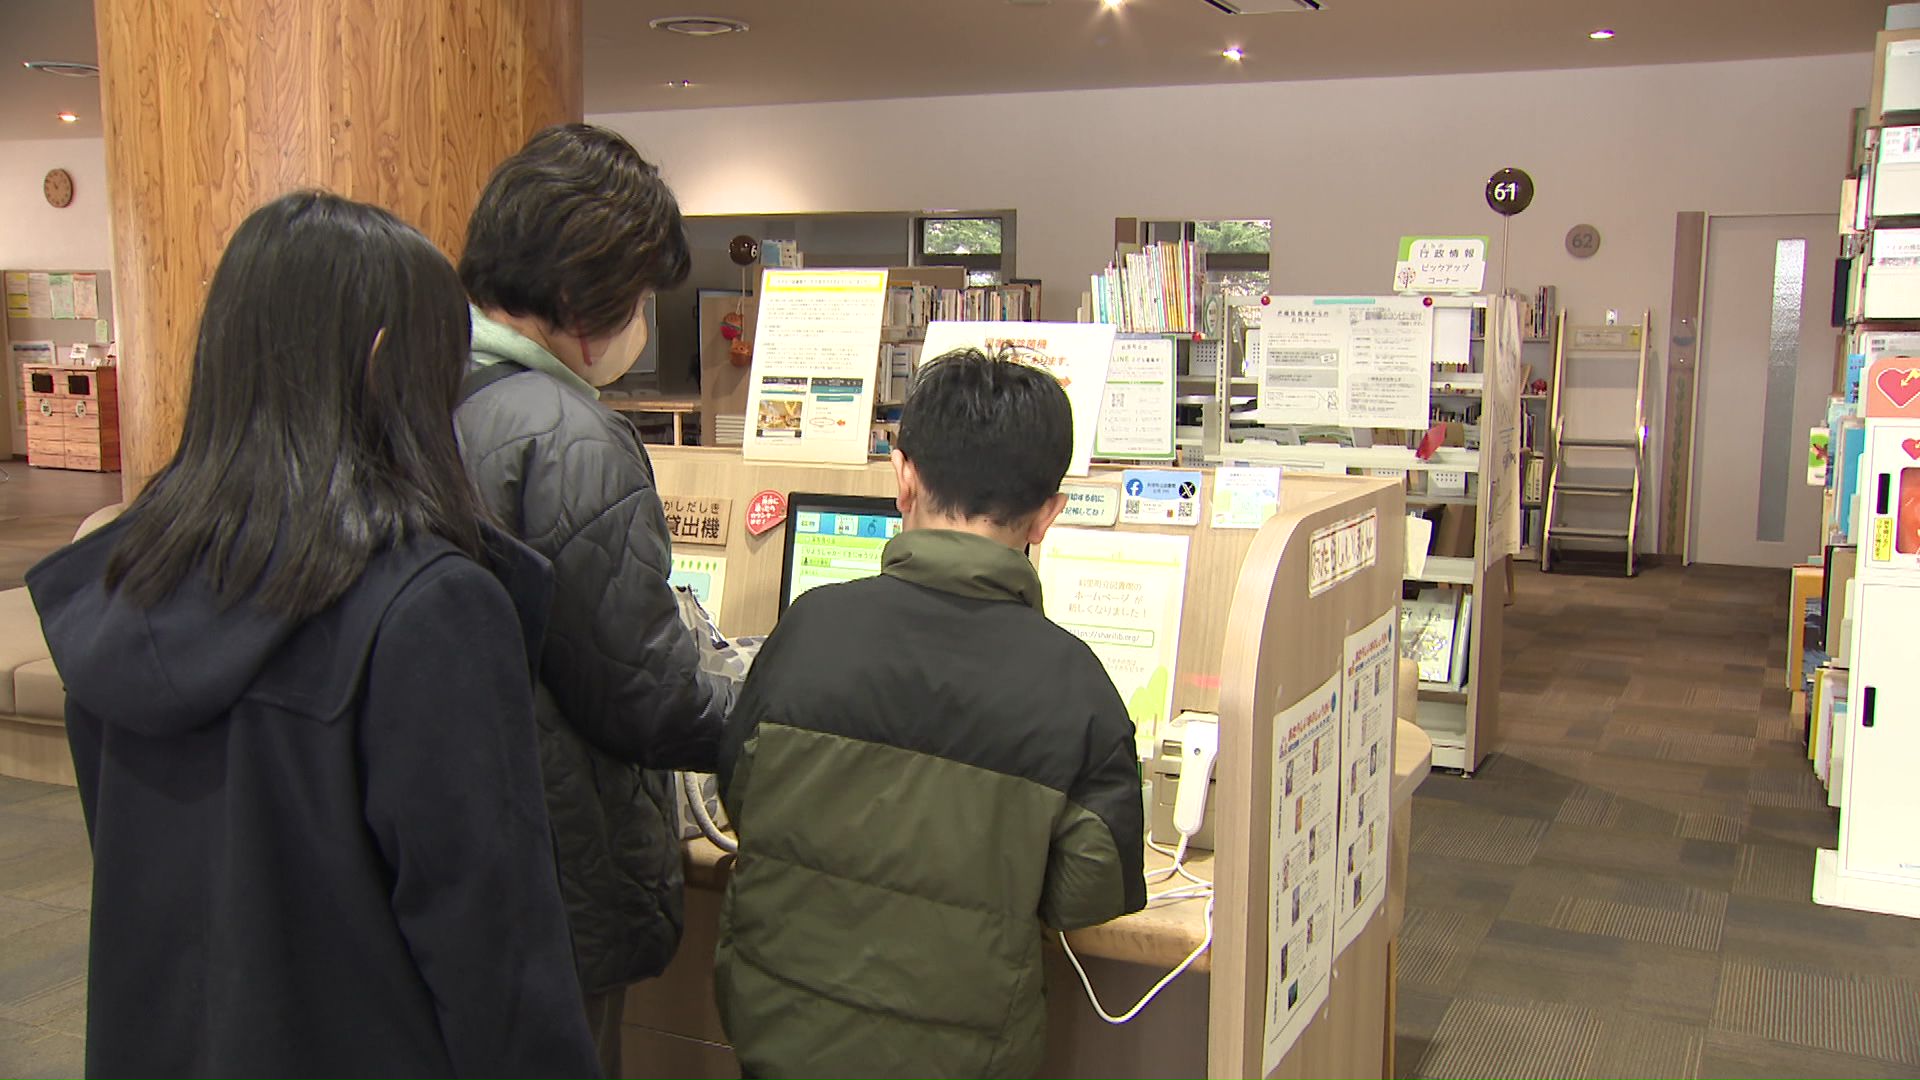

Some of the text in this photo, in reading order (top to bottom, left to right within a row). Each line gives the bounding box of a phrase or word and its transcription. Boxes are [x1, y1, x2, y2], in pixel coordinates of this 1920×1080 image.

[1493, 182, 1517, 201] 61
[1572, 233, 1593, 249] 62
[1419, 248, 1475, 259] 行政情報
[1421, 263, 1470, 272] ピックアップ
[1427, 277, 1459, 285] コーナー
[665, 515, 720, 539] 貸出機
